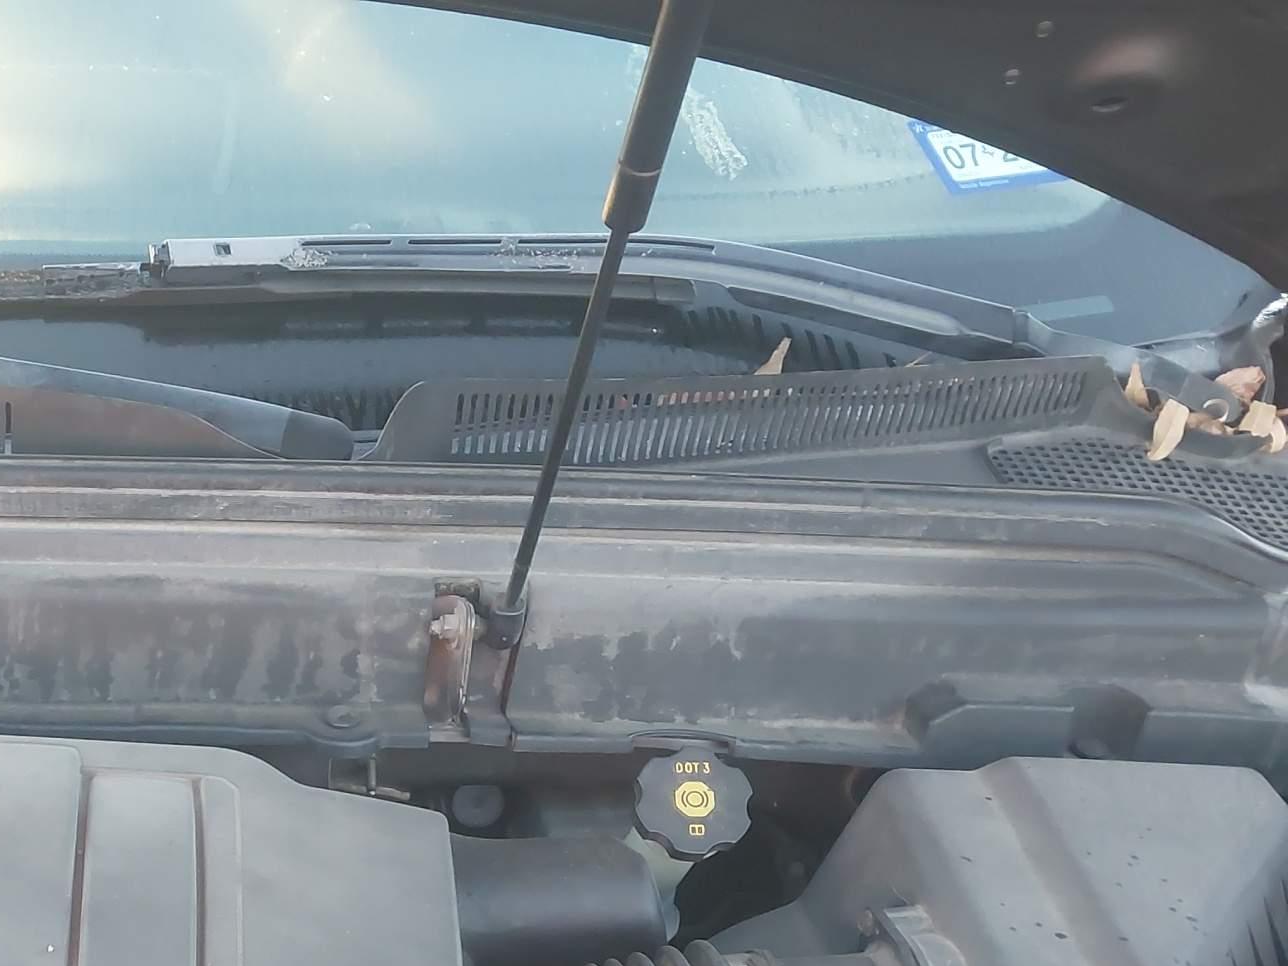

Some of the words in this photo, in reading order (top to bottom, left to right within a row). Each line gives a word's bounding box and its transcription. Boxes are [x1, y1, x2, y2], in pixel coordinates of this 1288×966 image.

[943, 143, 978, 169] 07
[676, 762, 699, 773] DOT
[703, 762, 710, 773] 3
